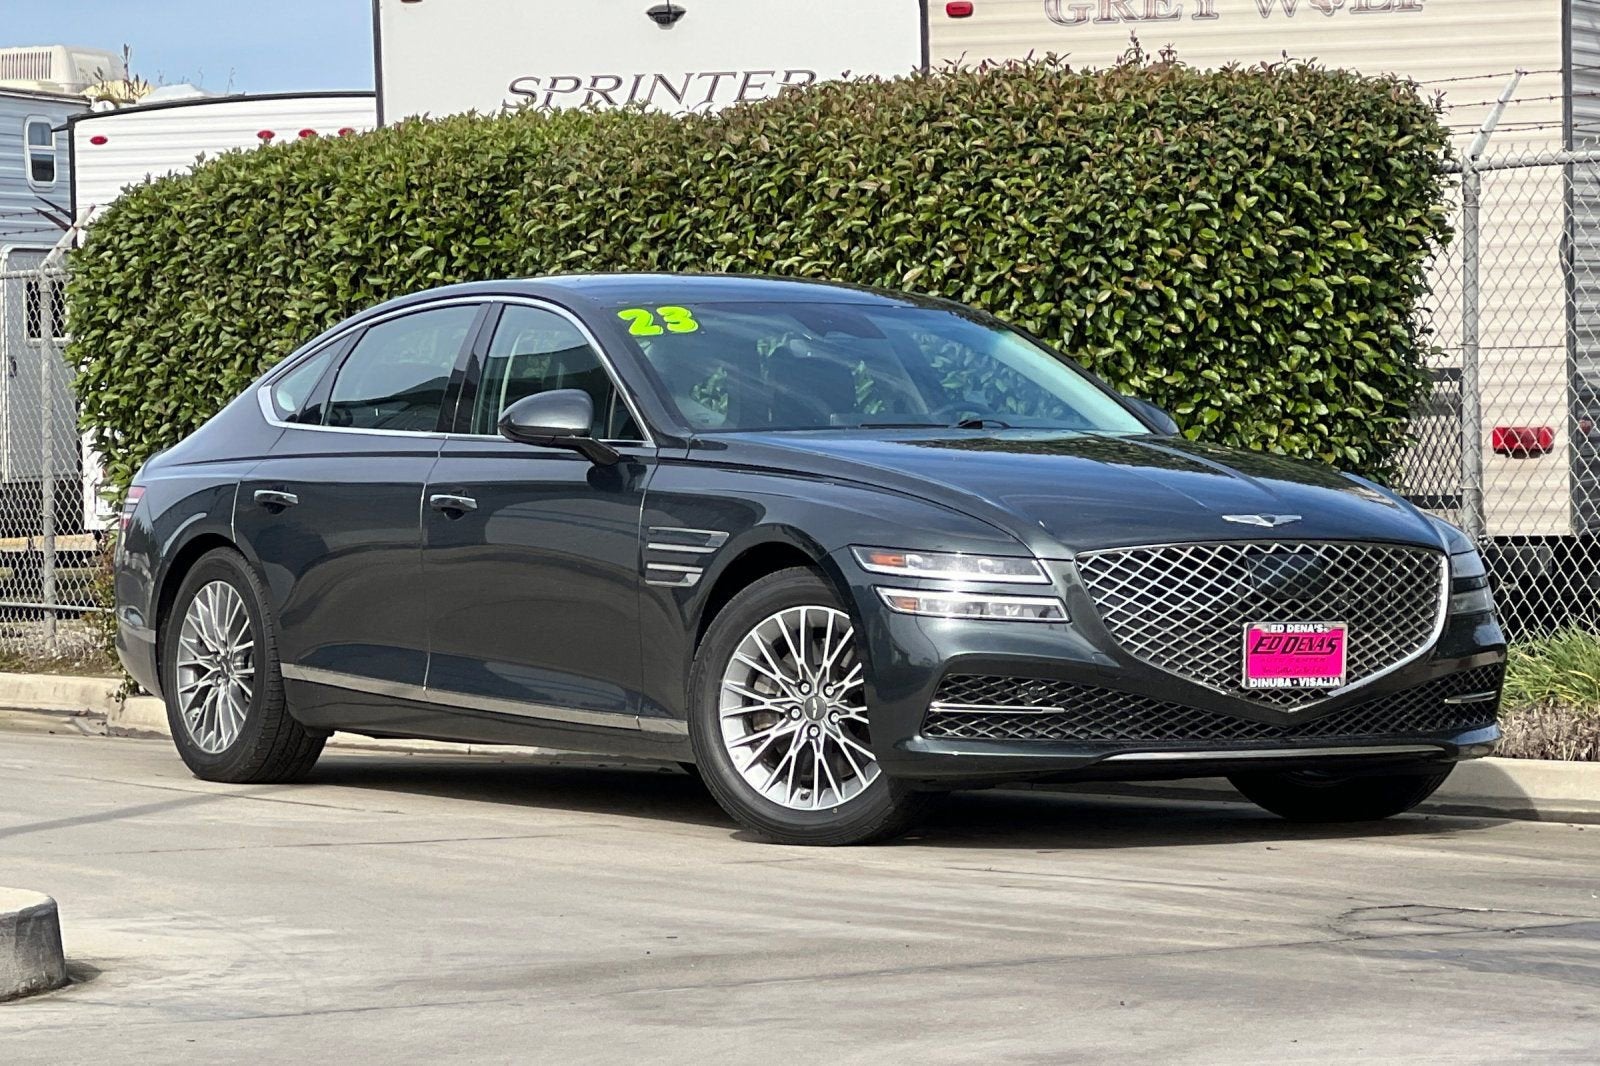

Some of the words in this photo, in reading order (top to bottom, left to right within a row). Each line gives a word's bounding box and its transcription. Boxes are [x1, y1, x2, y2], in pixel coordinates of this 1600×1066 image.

[501, 70, 816, 108] SPRINTER
[617, 306, 699, 336] 23
[1271, 625, 1285, 633] ED
[1287, 624, 1324, 633] DENA'S
[1251, 636, 1283, 655] ED
[1250, 678, 1292, 688] DINUBA
[1299, 676, 1341, 687] VISALIA
